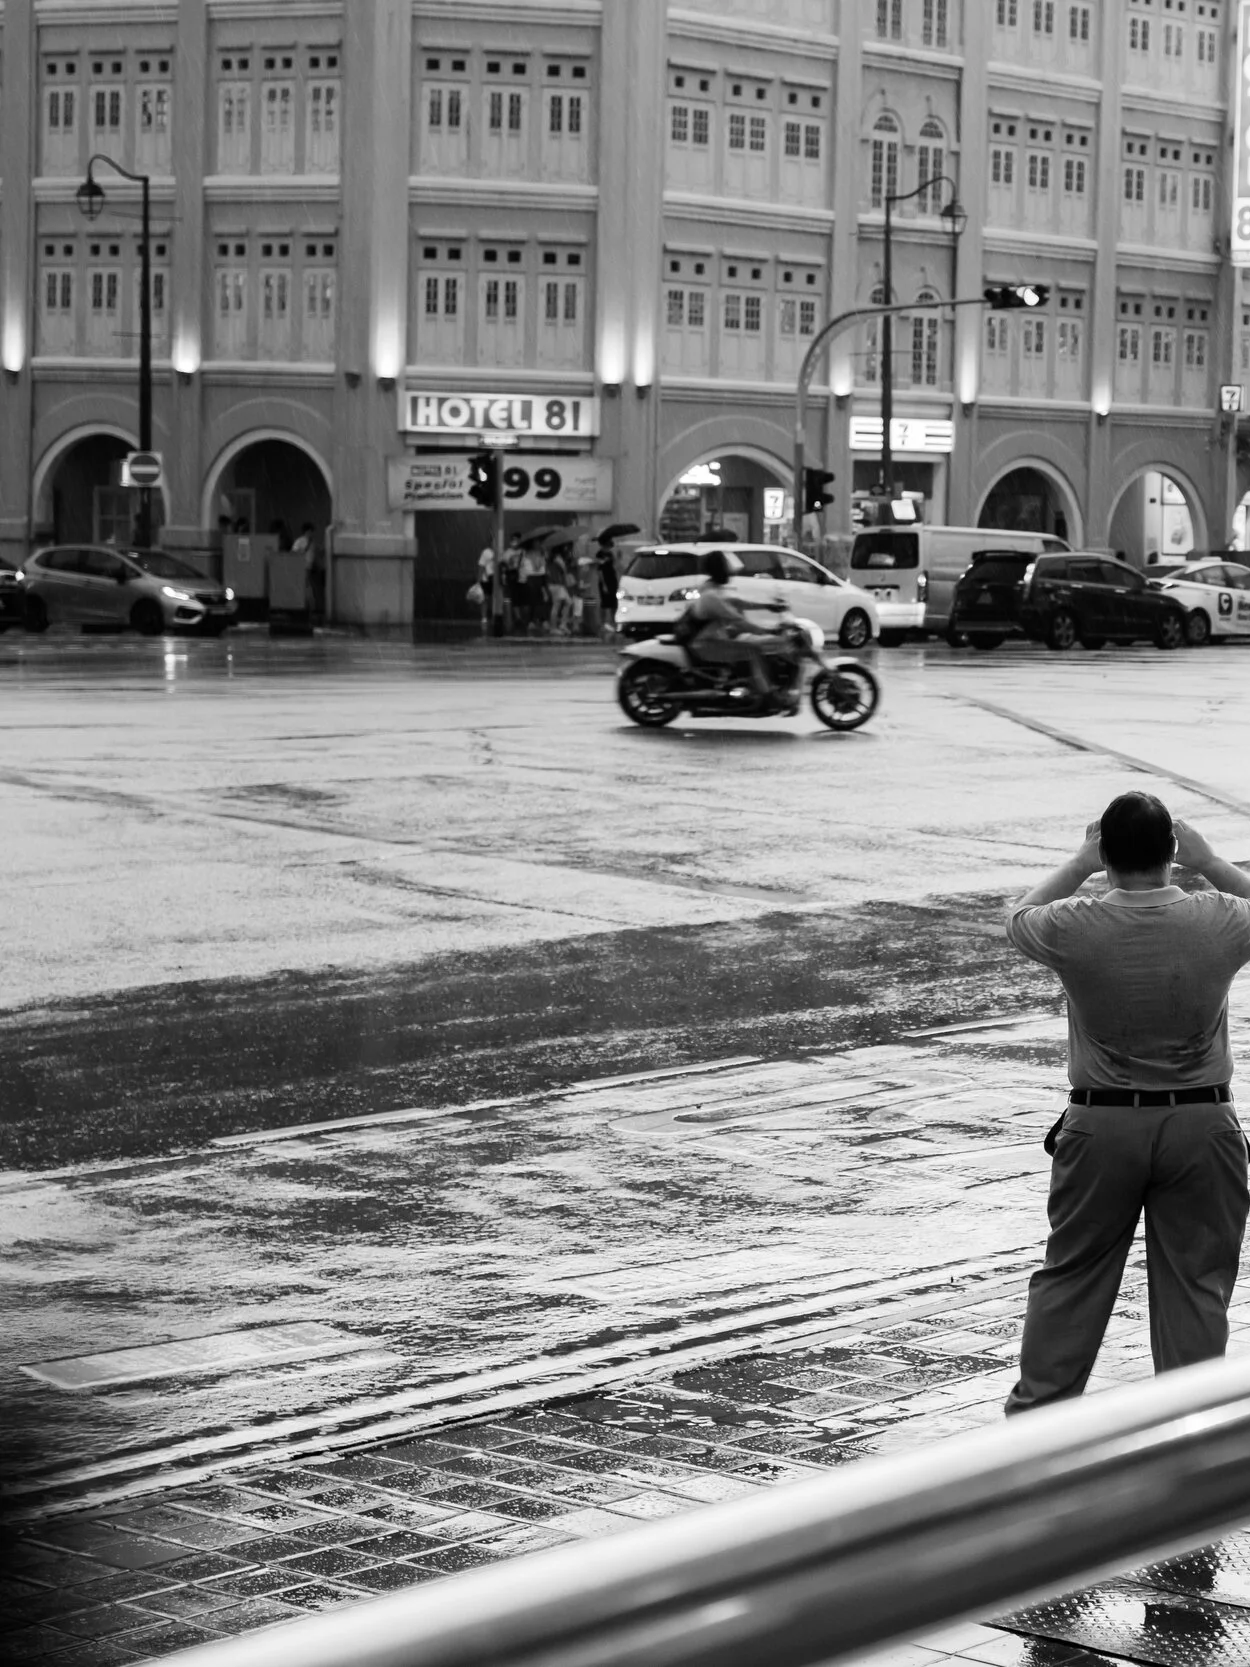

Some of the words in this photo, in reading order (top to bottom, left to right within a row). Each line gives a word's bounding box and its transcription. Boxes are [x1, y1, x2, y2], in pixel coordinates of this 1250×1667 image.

[416, 397, 530, 429] HOTEL
[545, 400, 581, 431] 81
[404, 479, 463, 491] Special
[503, 466, 562, 500] 99
